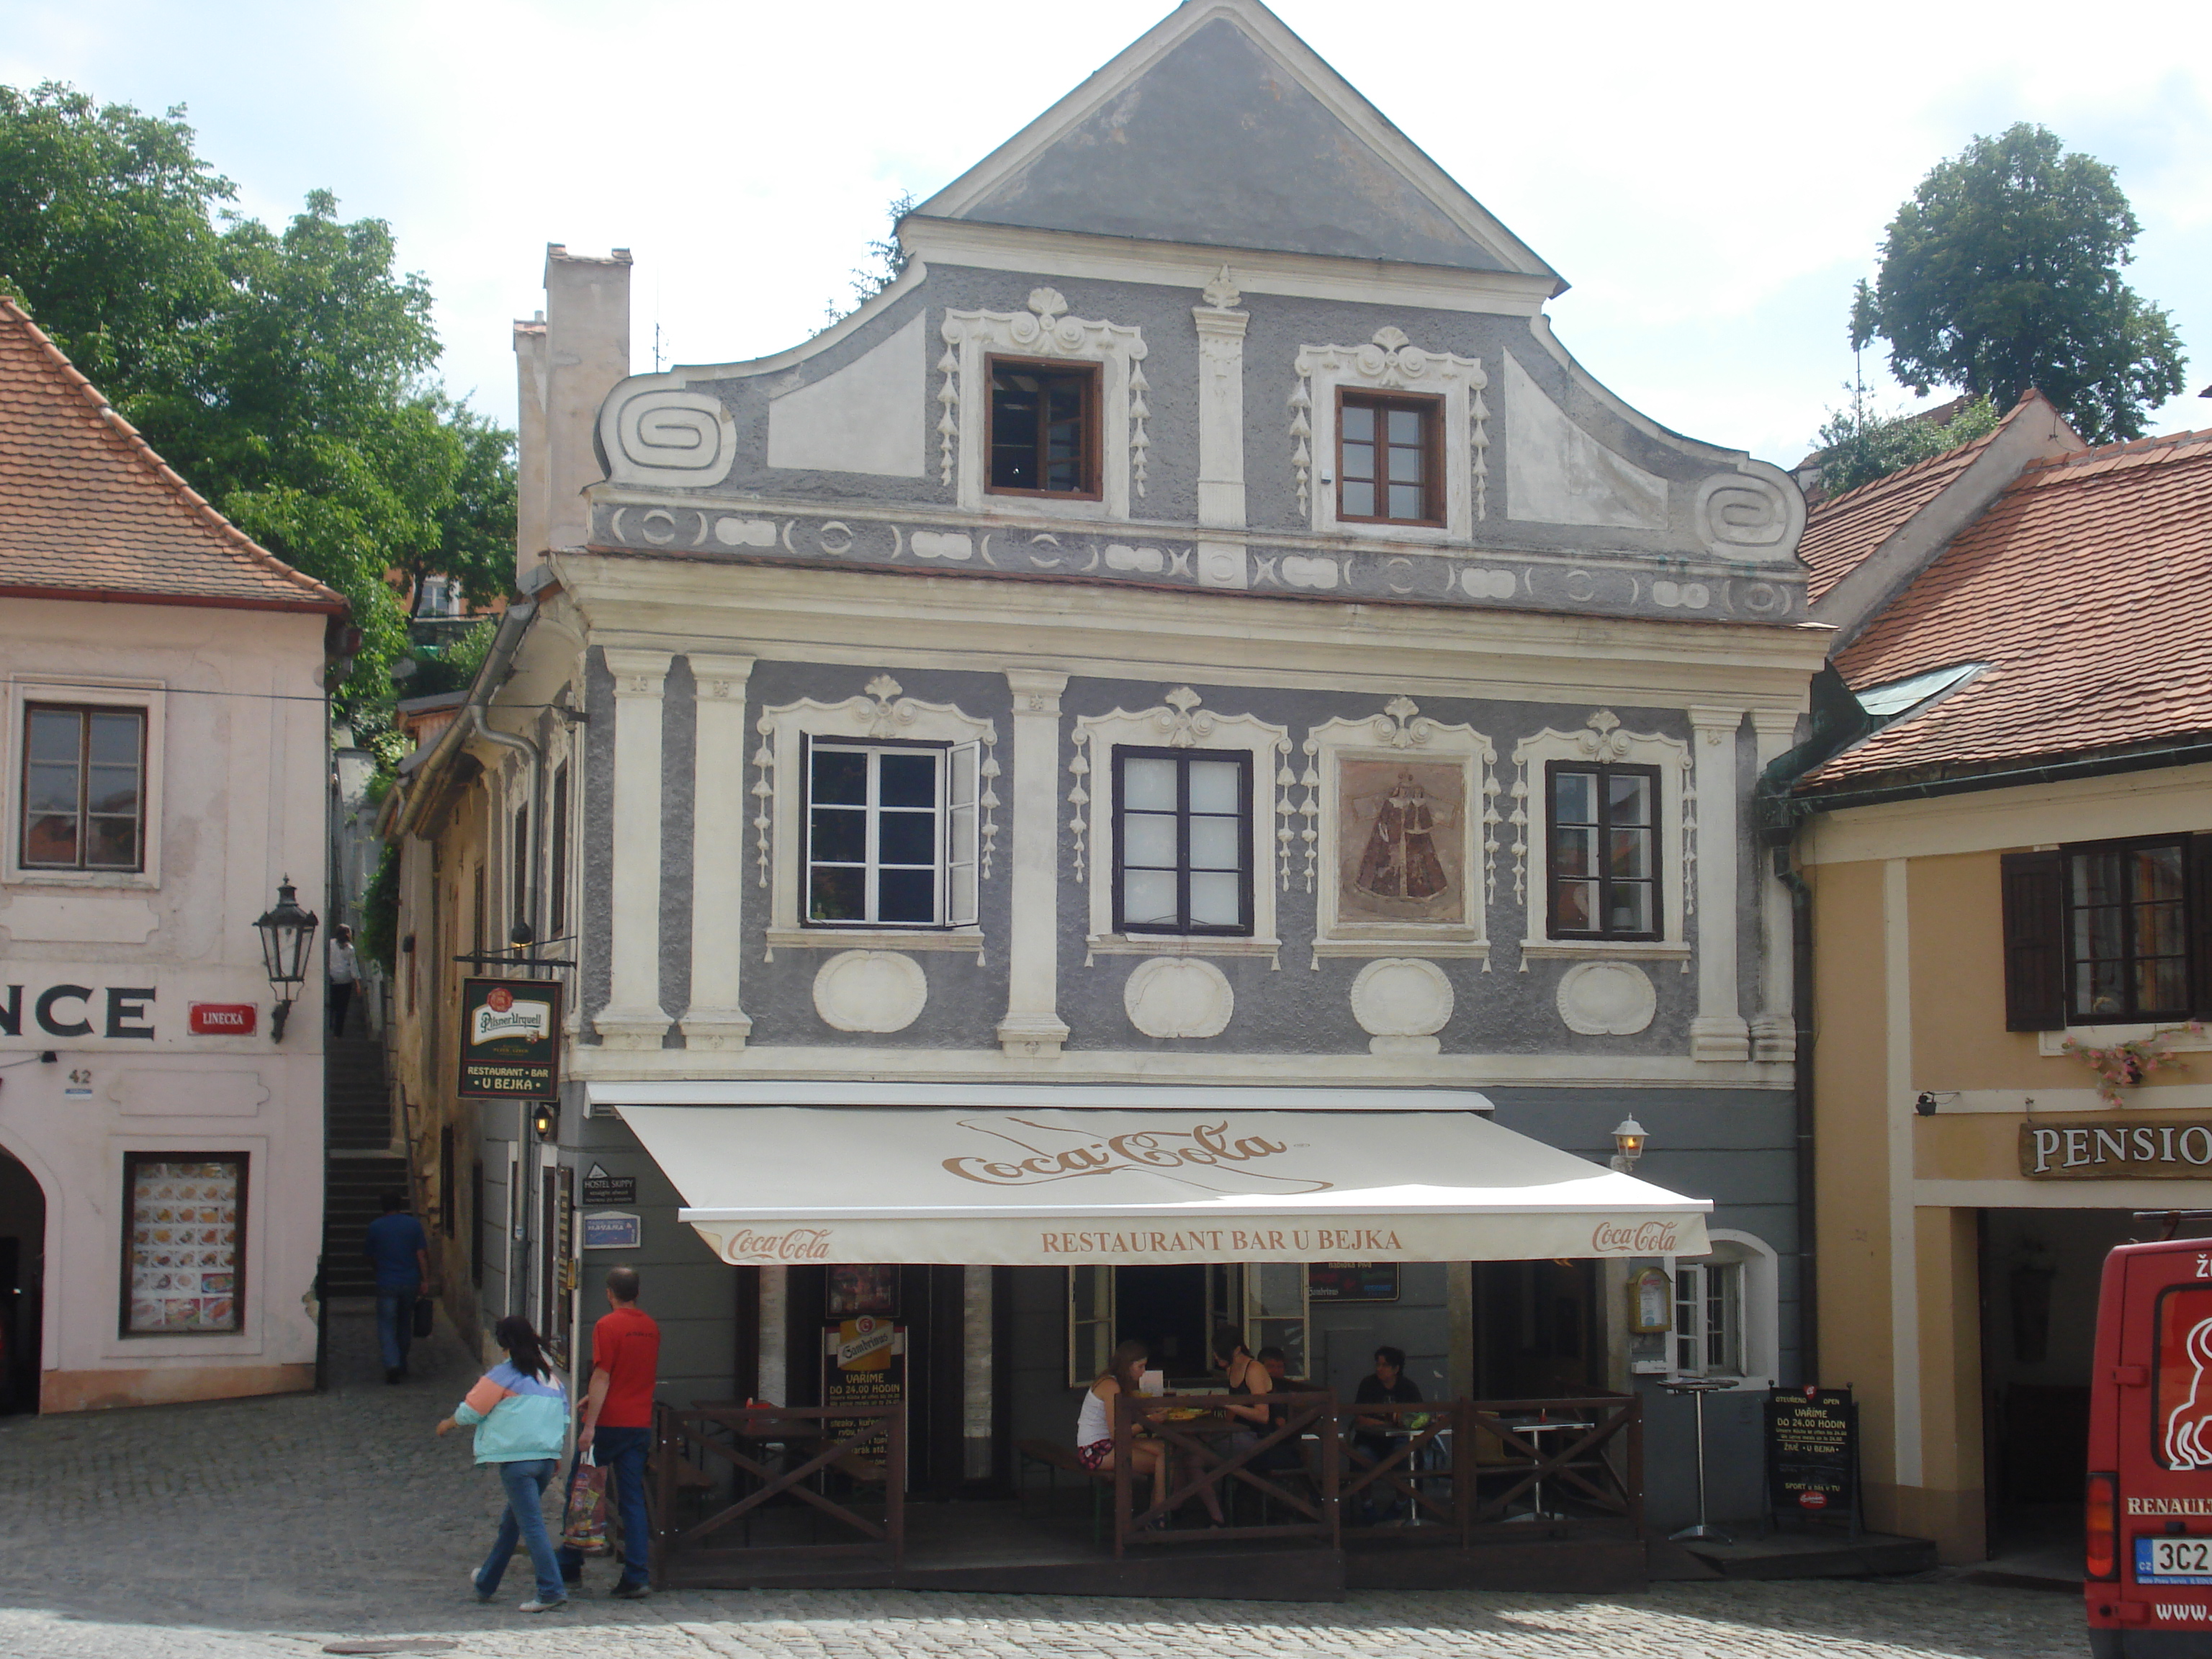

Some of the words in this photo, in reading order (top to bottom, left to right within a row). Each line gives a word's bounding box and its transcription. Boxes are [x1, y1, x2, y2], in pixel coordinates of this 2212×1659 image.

[481, 1012, 511, 1033] Pilsner
[511, 1012, 541, 1028] Urquell
[69, 1069, 91, 1084] 42
[467, 1066, 524, 1076] RESTAURANT
[531, 1068, 549, 1078] BAR
[482, 1078, 491, 1089] U
[494, 1078, 533, 1091] BEJKA
[942, 1118, 1298, 1187] Coca-Cola
[584, 1179, 610, 1189] HOSTEL
[727, 1228, 833, 1260] Coca-Cola
[1042, 1230, 1224, 1254] RESTAURANT
[1232, 1229, 1287, 1251] BAR
[1291, 1230, 1310, 1251] U
[1318, 1229, 1403, 1250] BEJKA
[1591, 1221, 1678, 1252] Coca-Cola
[2196, 1254, 2212, 1277] Ž
[842, 1333, 889, 1359] Gambrinus
[830, 1385, 842, 1395] DO
[845, 1385, 869, 1394] 24.00
[872, 1384, 900, 1393] HODIN
[1777, 1418, 1789, 1427] DO
[1792, 1419, 1815, 1428] 24.00
[1818, 1420, 1845, 1429] HODIN
[1785, 1483, 1806, 1491] SPORT
[2139, 1562, 2152, 1571] CZ
[2159, 1543, 2209, 1571] 3C2
[2155, 1603, 2212, 1622] www.
